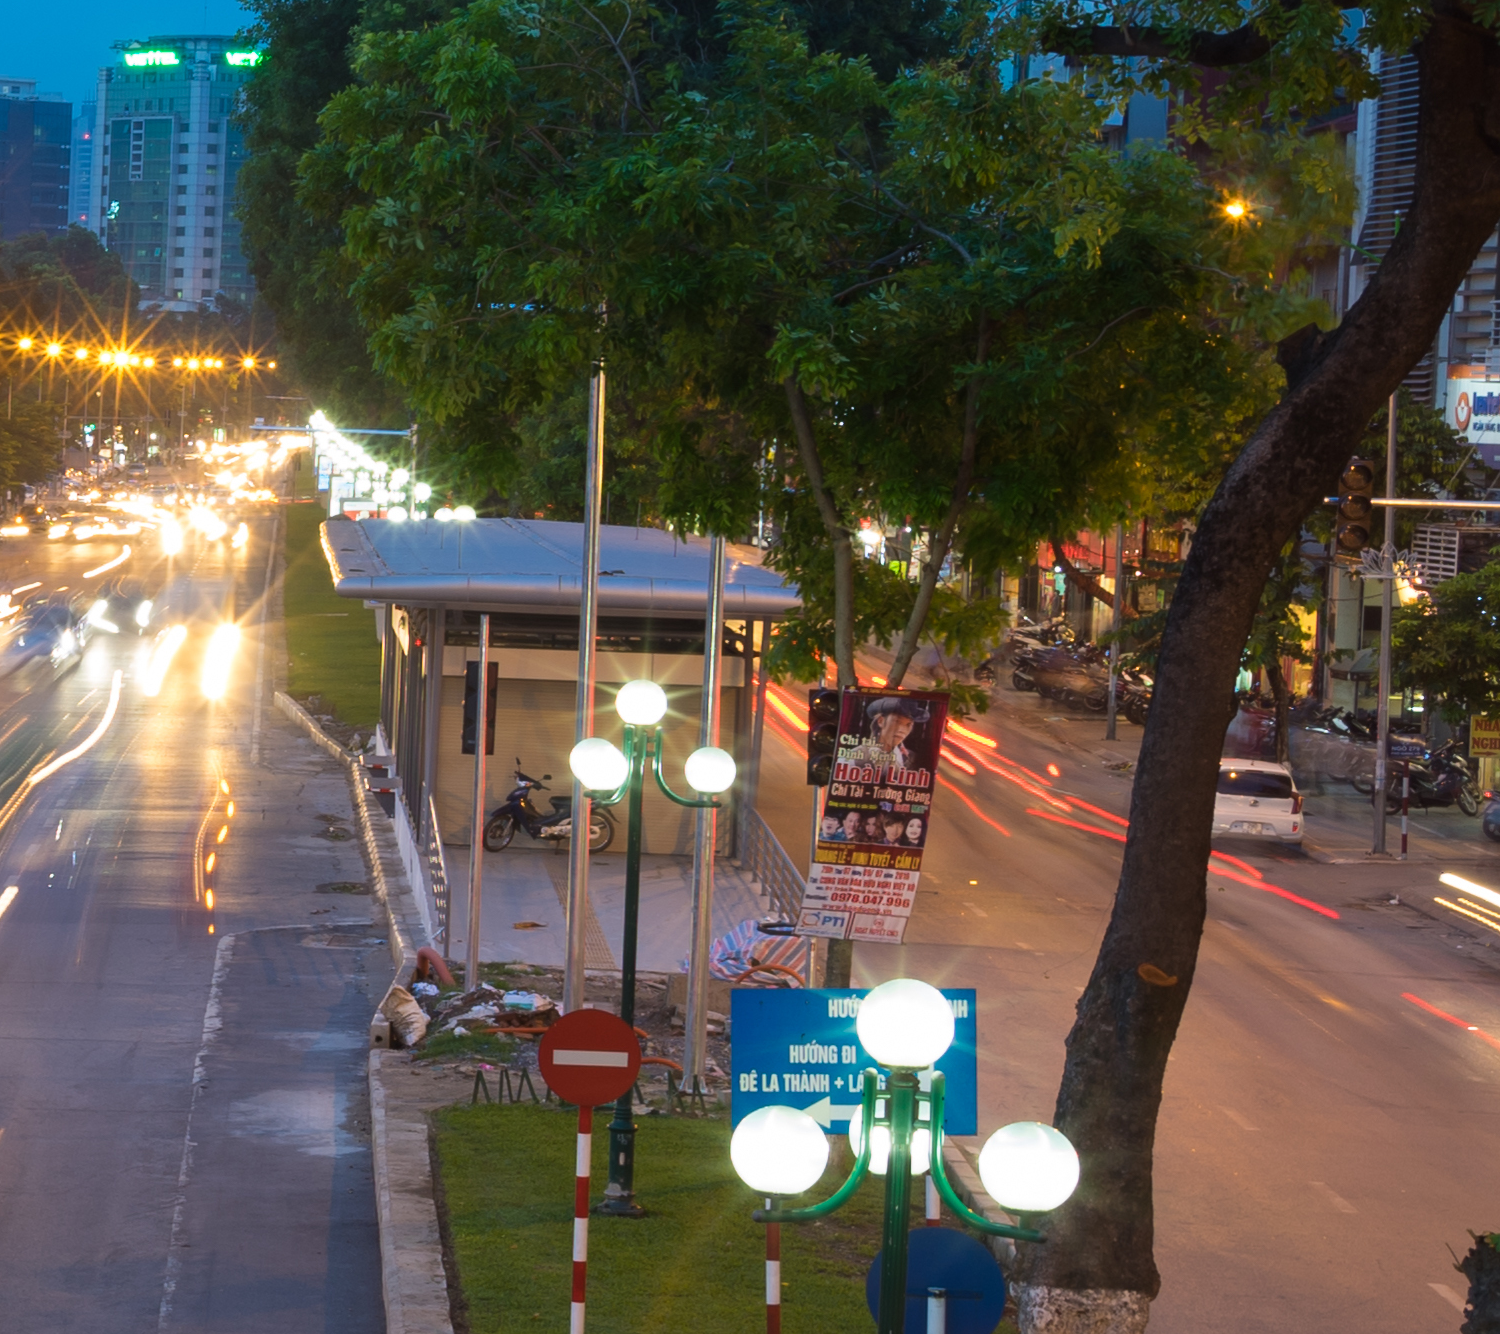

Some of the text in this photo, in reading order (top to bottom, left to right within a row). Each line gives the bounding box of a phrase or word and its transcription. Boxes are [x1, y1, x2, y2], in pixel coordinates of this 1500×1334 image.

[833, 763, 930, 788] Hoài Linh
[905, 789, 931, 805] Giang
[830, 893, 911, 908] 0978.047.996
[821, 916, 845, 928] PTI
[789, 1039, 857, 1064] HƯỚNG ĐI
[739, 1069, 758, 1092] ĐÊ
[762, 1074, 780, 1093] LA
[783, 1069, 830, 1093] THÀNH
[834, 1076, 845, 1089] +
